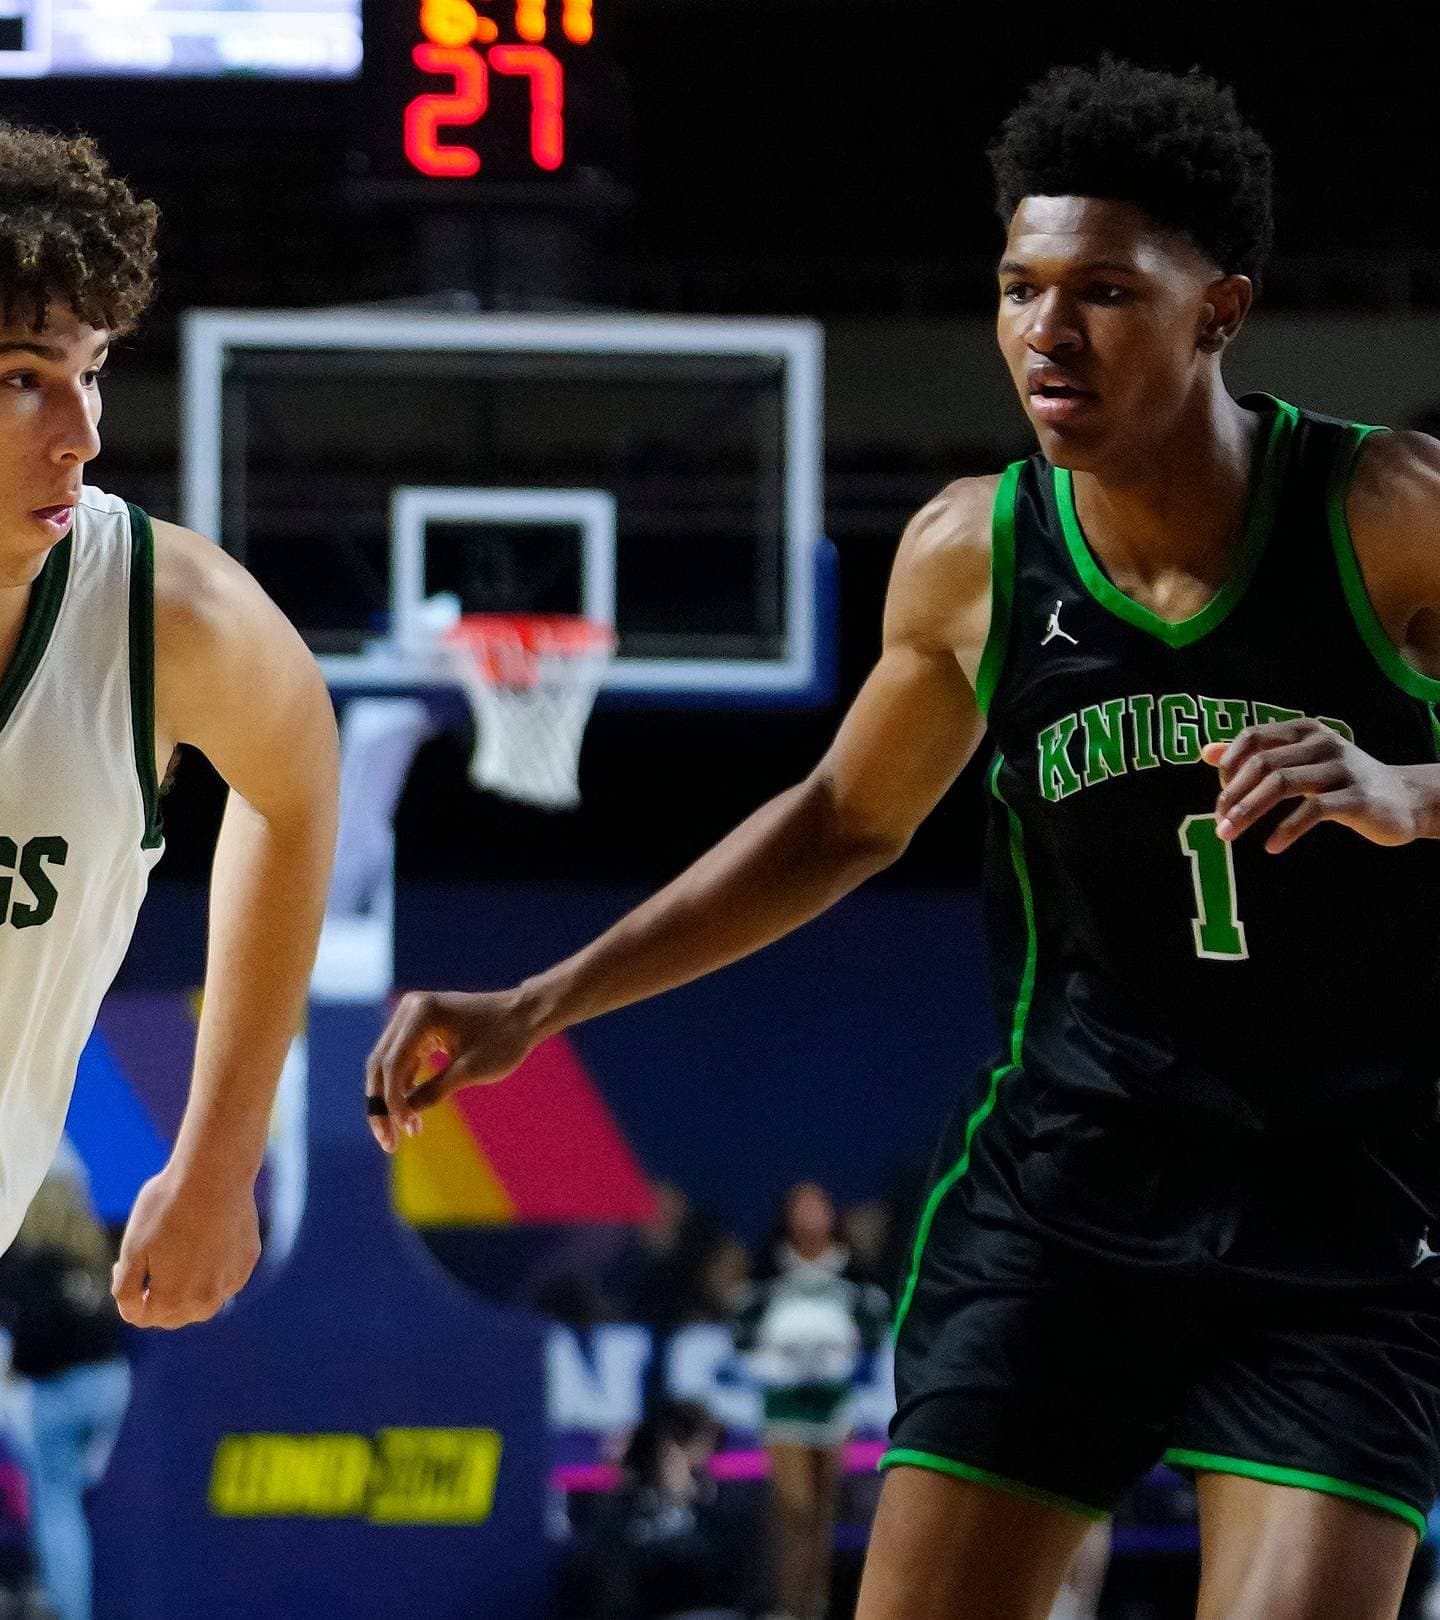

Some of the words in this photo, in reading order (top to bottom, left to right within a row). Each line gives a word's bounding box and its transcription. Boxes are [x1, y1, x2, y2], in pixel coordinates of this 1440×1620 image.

[404, 43, 565, 177] 27
[1038, 693, 1354, 802] KNIGH
[1177, 813, 1250, 960] 1
